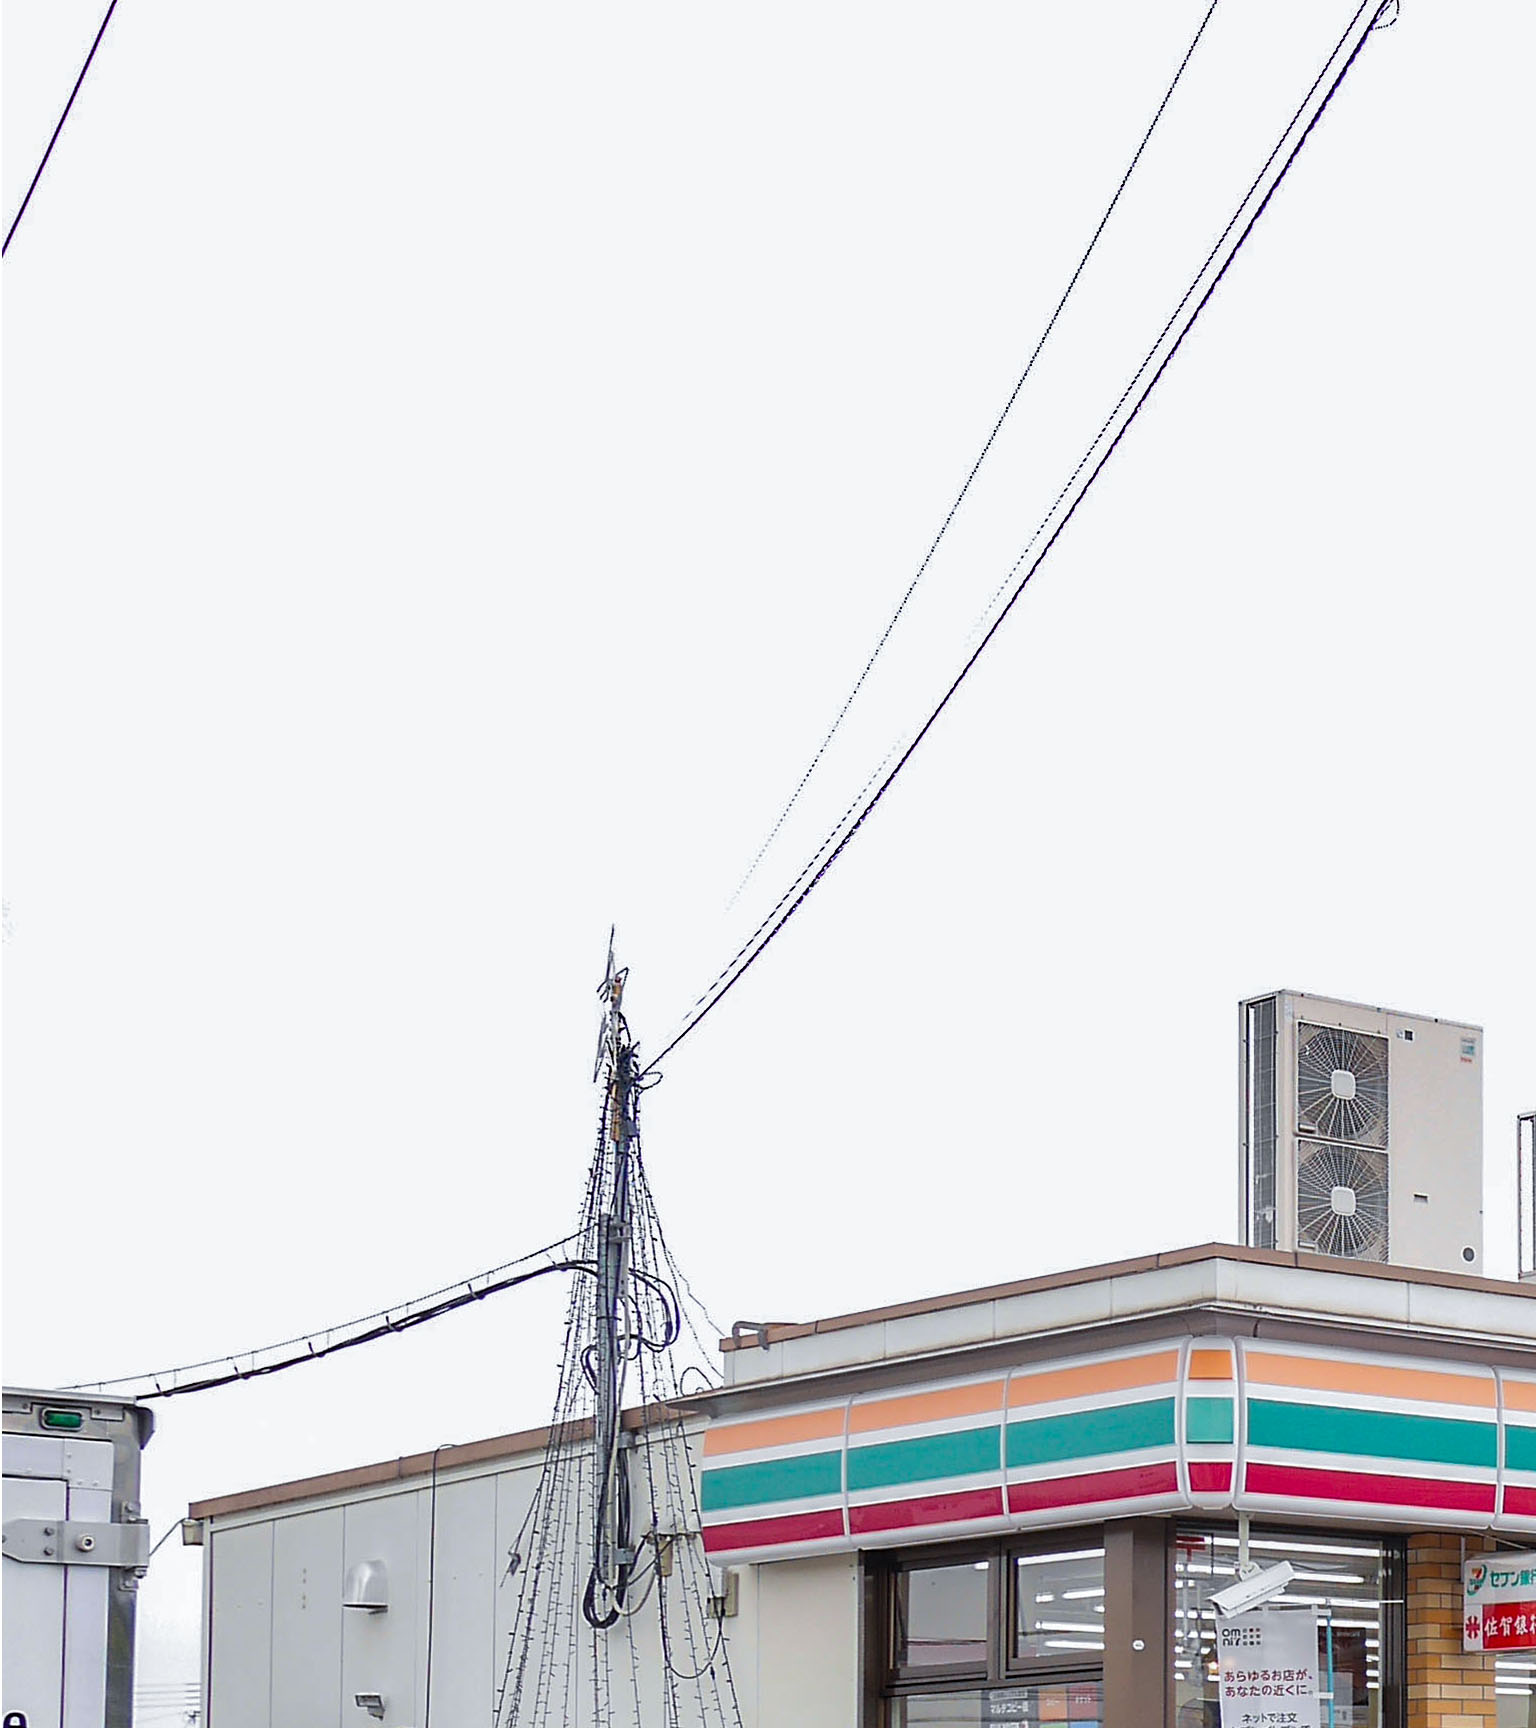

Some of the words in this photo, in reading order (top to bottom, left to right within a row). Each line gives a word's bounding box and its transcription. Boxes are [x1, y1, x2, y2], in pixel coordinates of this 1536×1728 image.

[1224, 1668, 1313, 1683] あらゆるお店が、
[1241, 1712, 1298, 1724] ネットで注文
